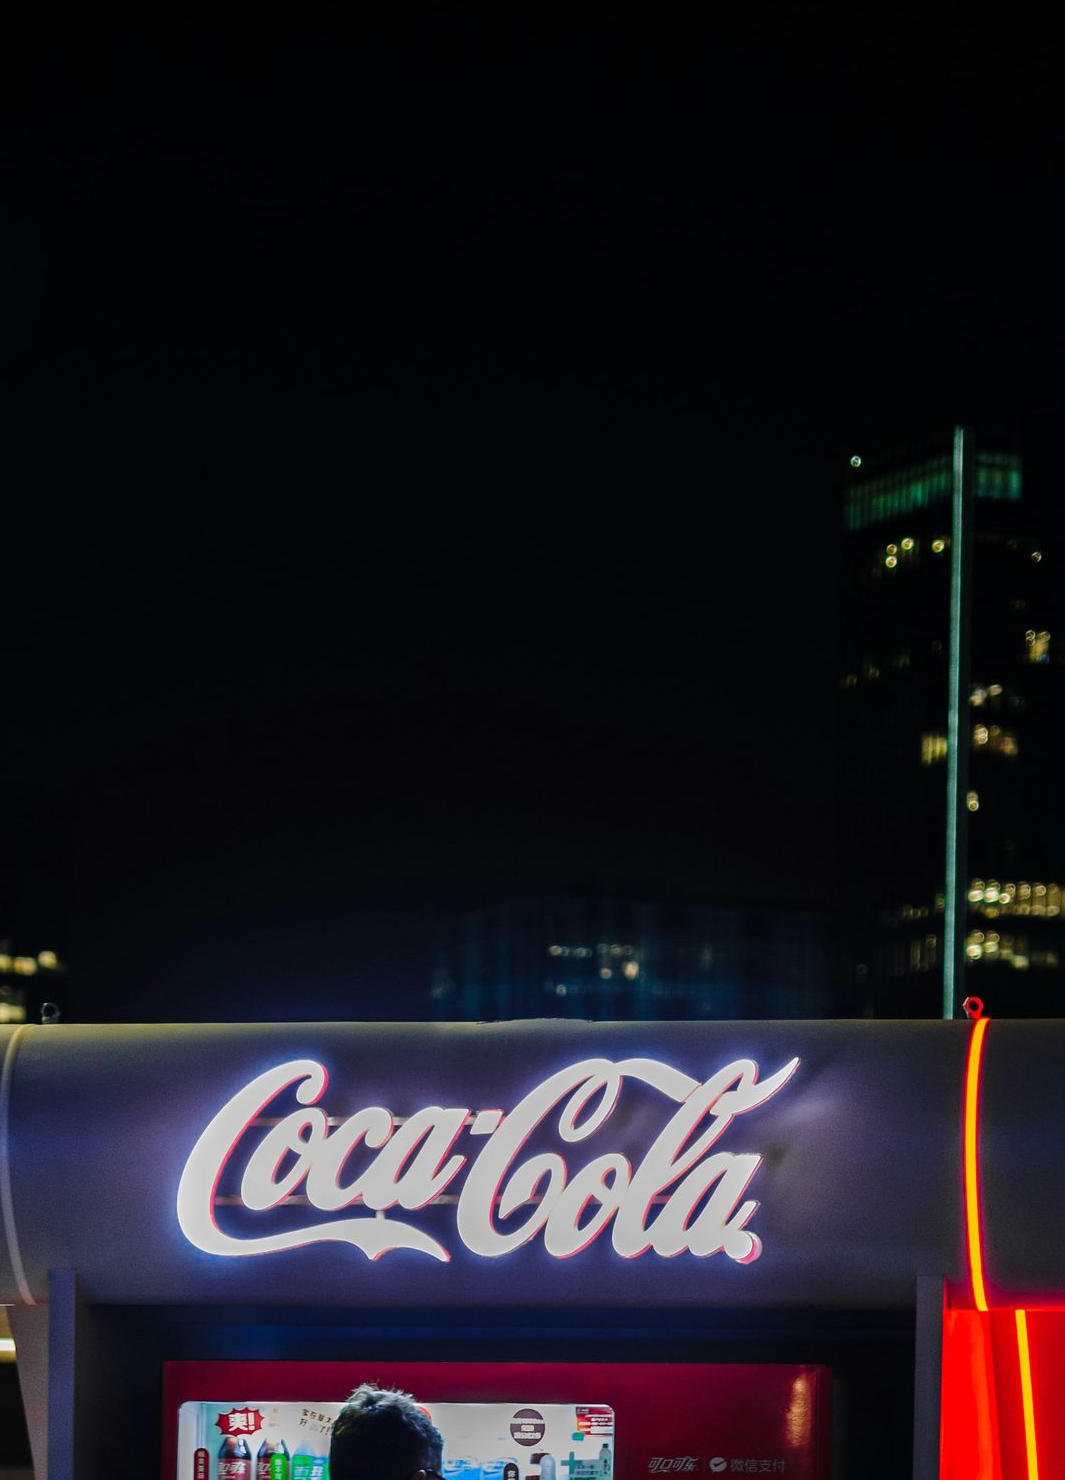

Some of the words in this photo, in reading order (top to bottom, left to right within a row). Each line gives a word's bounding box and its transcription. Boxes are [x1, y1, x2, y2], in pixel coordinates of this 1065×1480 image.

[177, 1057, 800, 1262] Coca-Cola
[648, 1456, 698, 1473] 可口可乐
[730, 1458, 785, 1473] 微信支付
